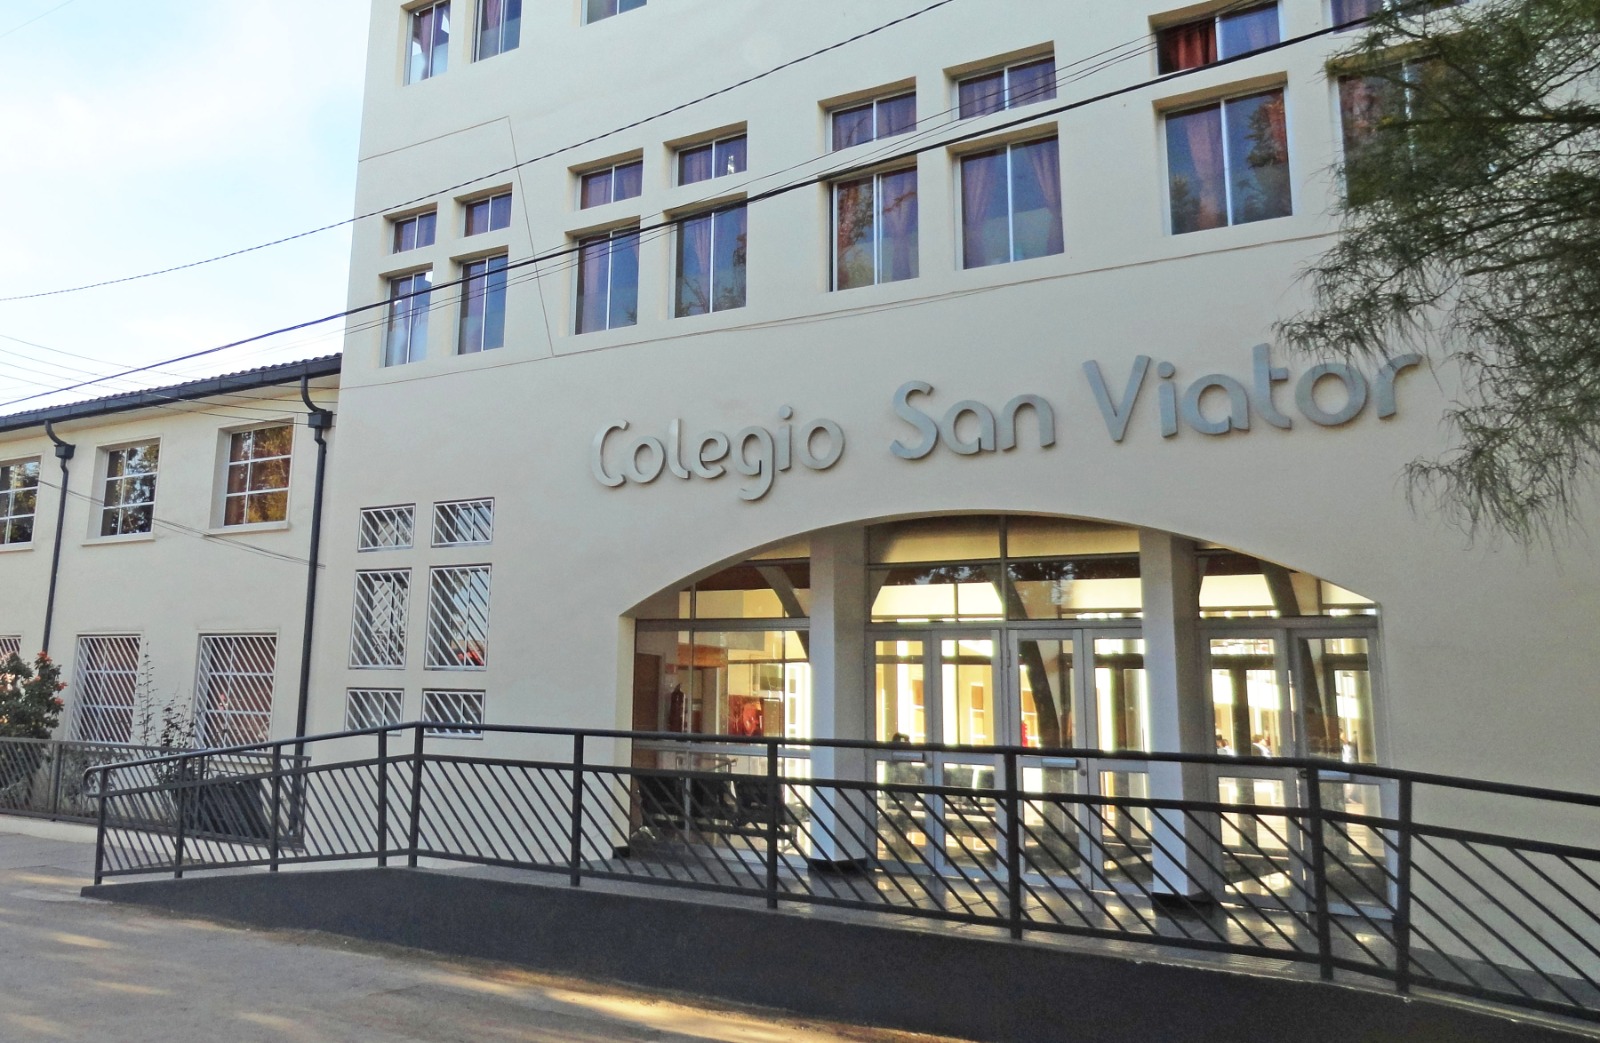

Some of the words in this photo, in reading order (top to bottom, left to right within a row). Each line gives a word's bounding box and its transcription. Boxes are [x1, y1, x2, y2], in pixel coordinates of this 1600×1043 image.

[591, 404, 845, 501] Colegio
[889, 380, 1056, 460] San
[1081, 342, 1423, 443] Viator
